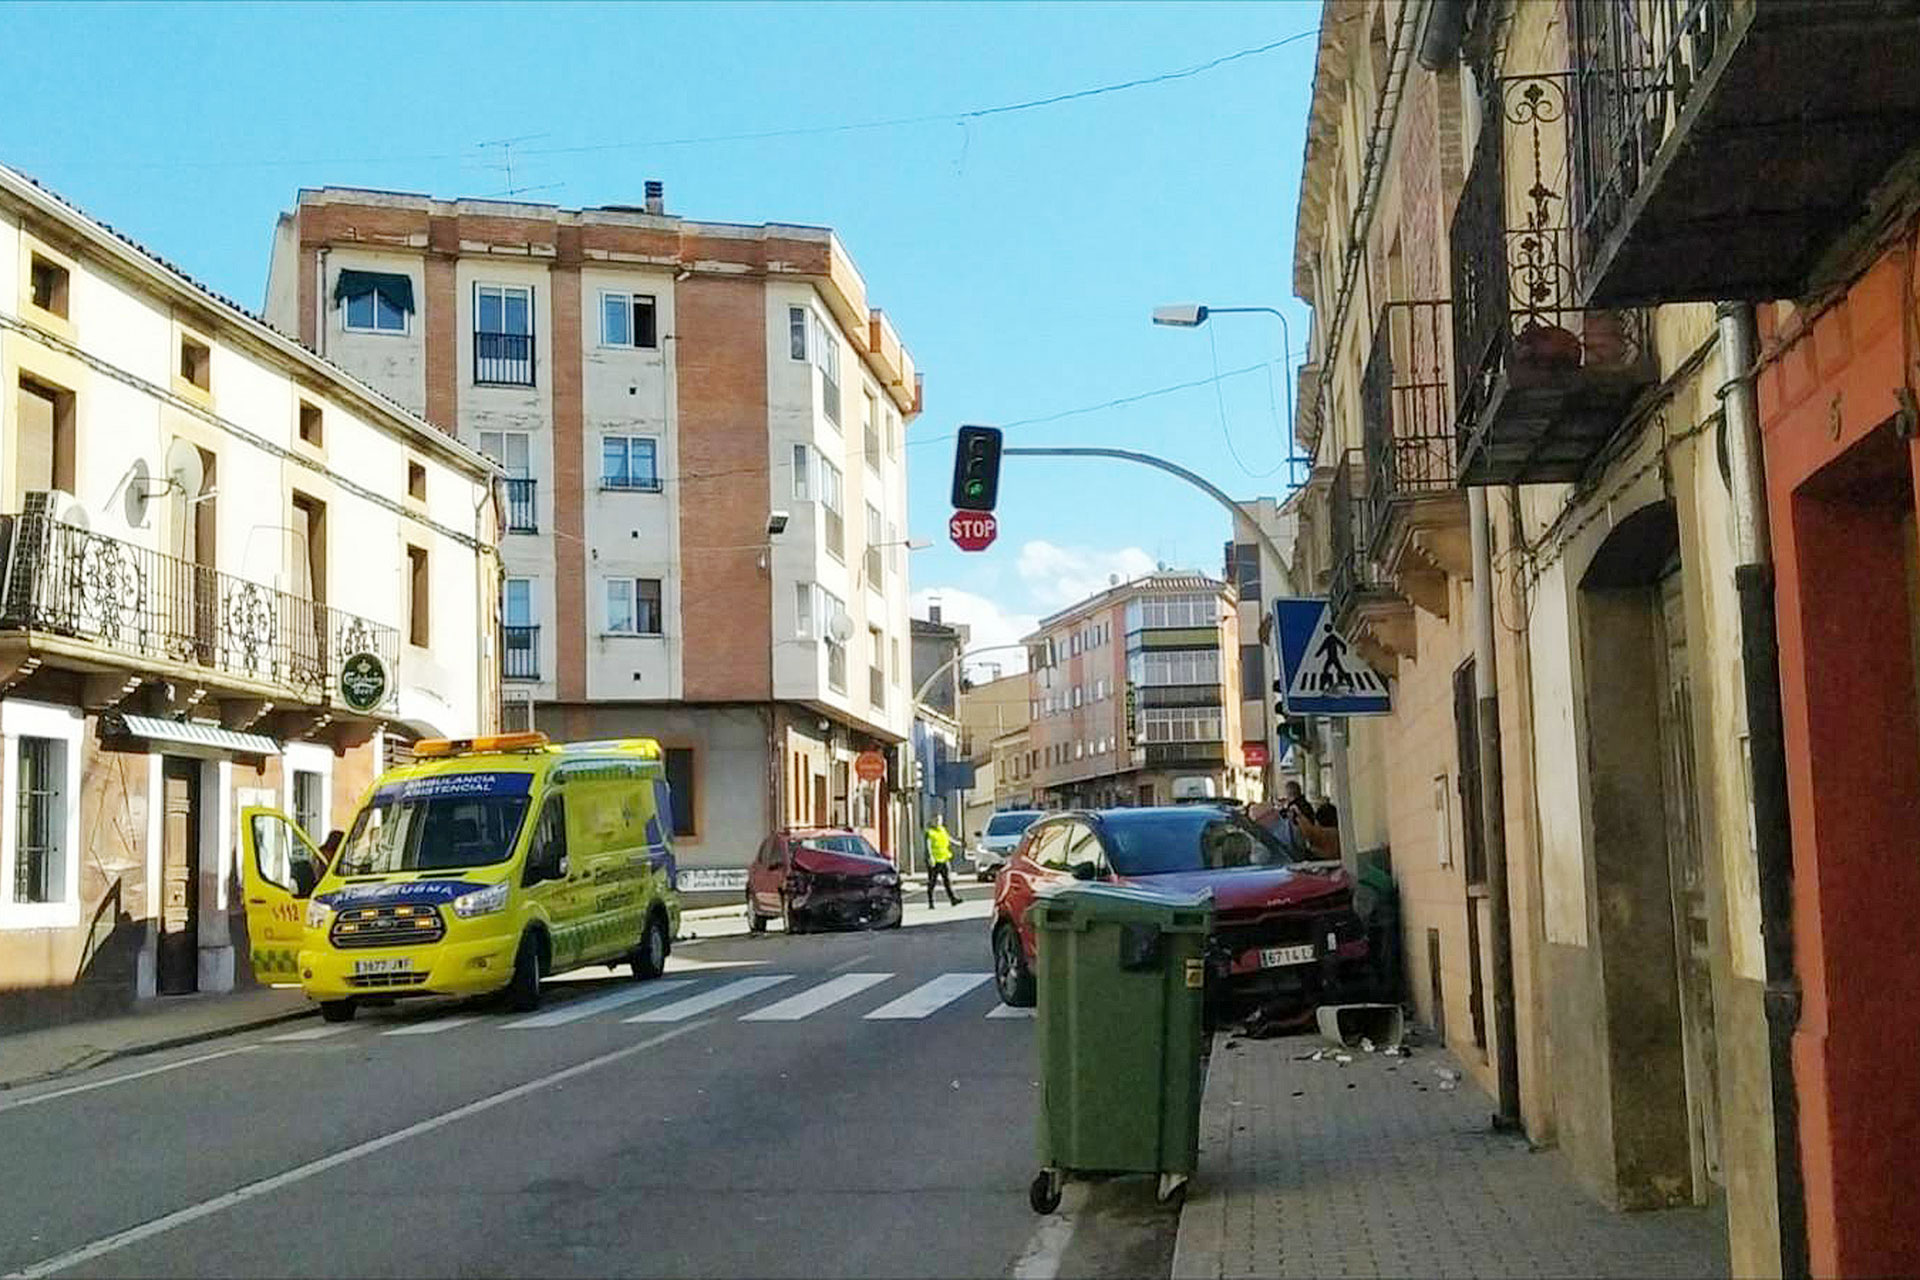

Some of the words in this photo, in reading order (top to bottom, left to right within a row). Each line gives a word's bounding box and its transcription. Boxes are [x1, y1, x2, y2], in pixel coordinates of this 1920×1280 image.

[951, 520, 995, 538] STOP
[404, 775, 496, 790] AMBULANCIA
[402, 784, 492, 798] ASISTENCIAL
